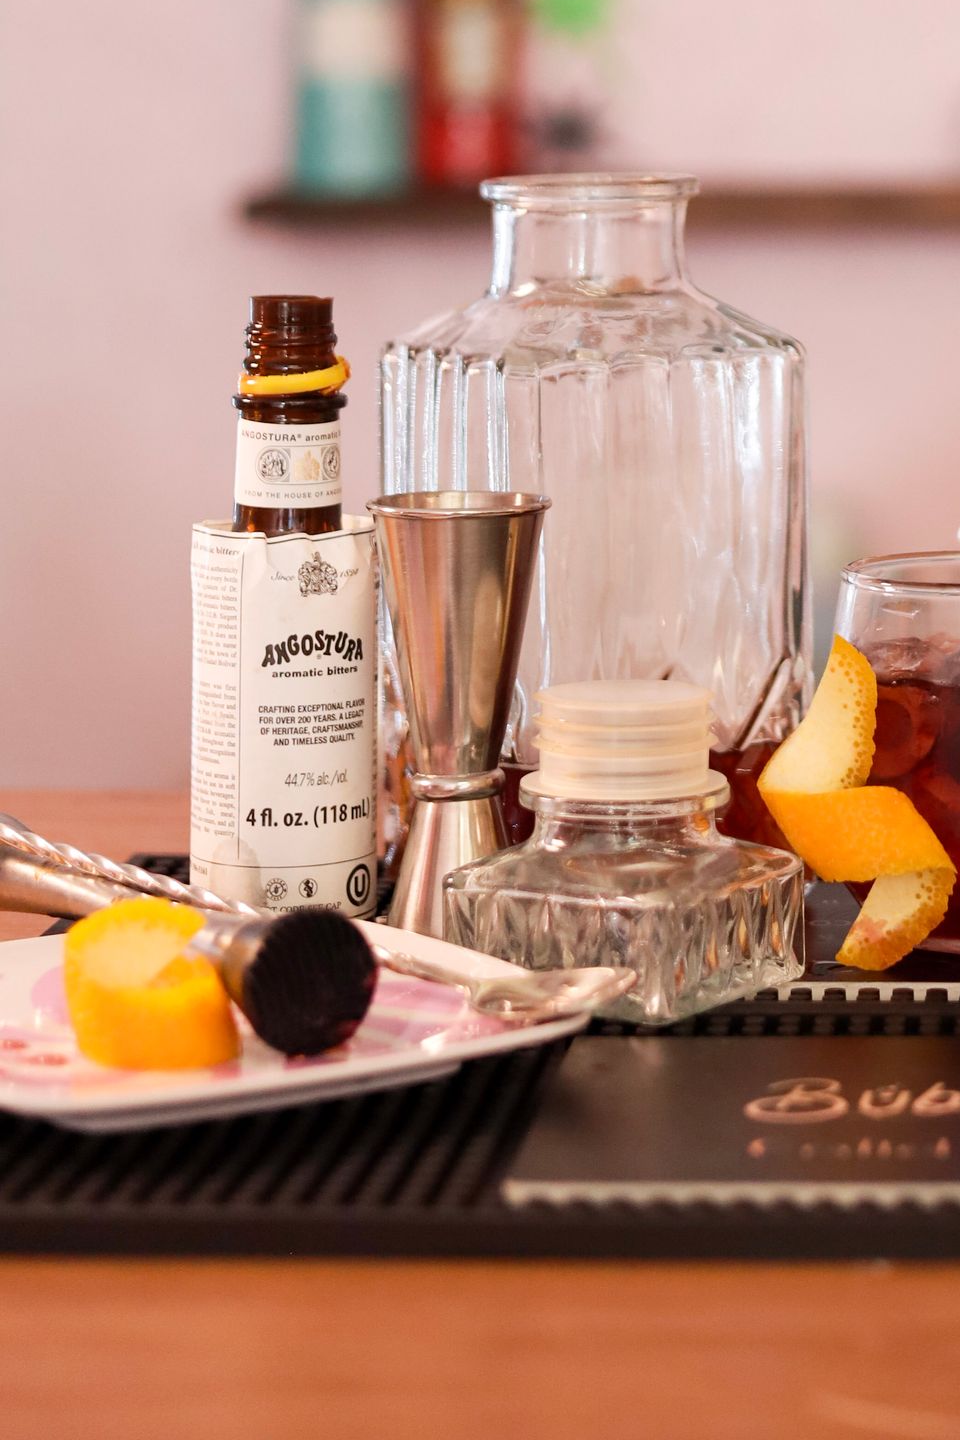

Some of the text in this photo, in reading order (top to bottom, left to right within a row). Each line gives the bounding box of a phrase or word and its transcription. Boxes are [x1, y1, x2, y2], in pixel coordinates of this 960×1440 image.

[261, 629, 363, 668] ANGOSTURA
[272, 665, 358, 678] aromatic bitters
[258, 698, 365, 714] CRAFTING EXCEPTIONAL FLAVOR
[259, 716, 273, 724] FOR
[275, 715, 296, 724] OVER
[297, 715, 312, 724] 200
[338, 712, 343, 720] A
[345, 709, 364, 720] LEGACY
[260, 727, 270, 735] OF
[272, 726, 310, 735] HERITAGE,
[273, 738, 290, 747] AND
[292, 736, 327, 746] TIMELESS
[246, 808, 257, 827] 4
[260, 808, 278, 827] fl.
[283, 812, 308, 827] oz.
[313, 804, 348, 828] (118
